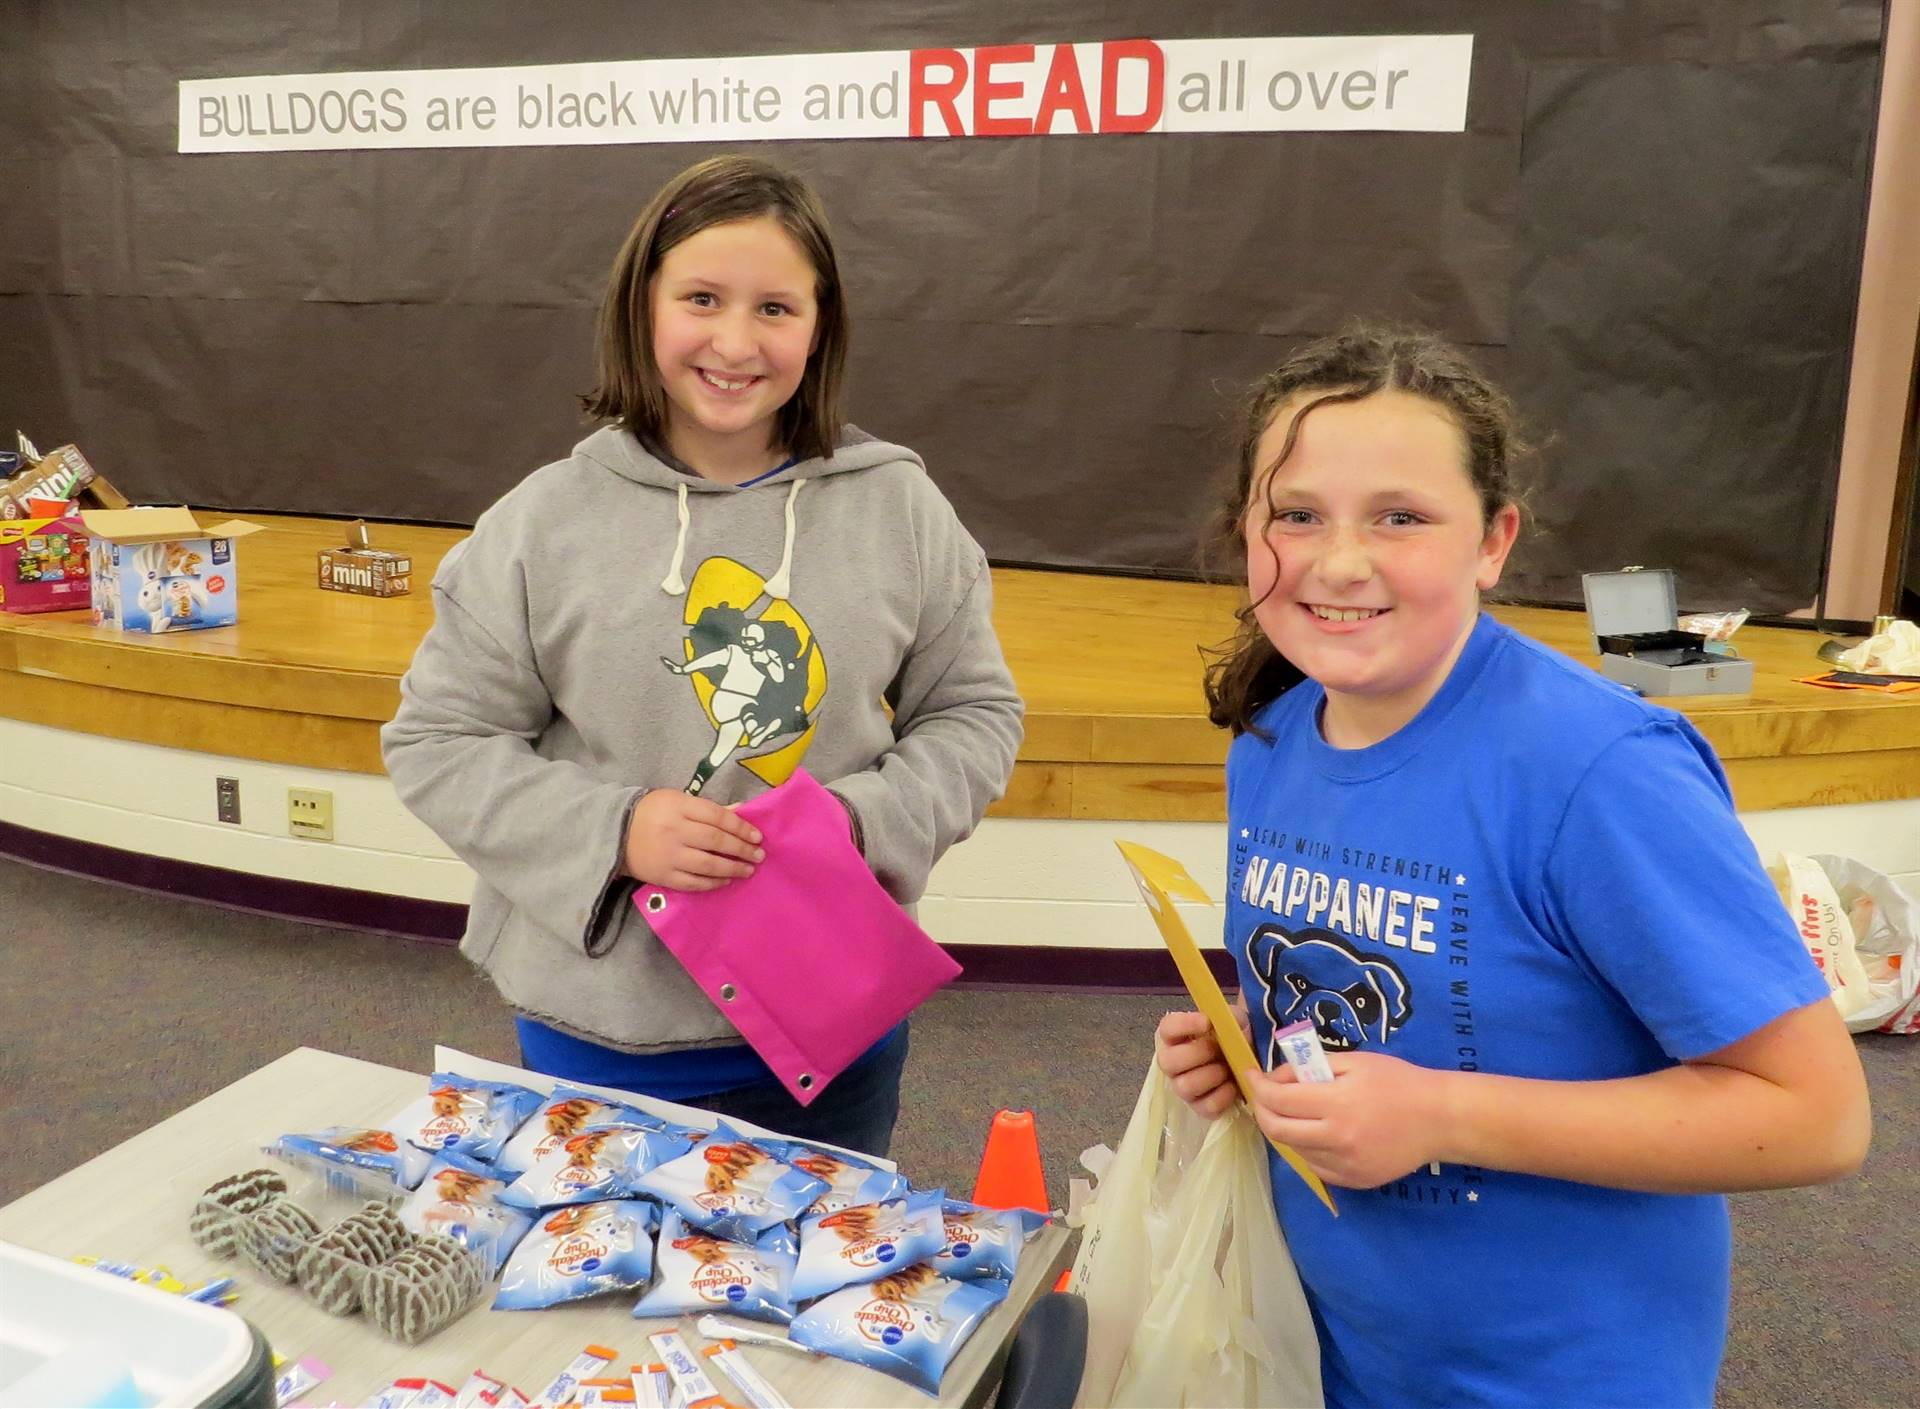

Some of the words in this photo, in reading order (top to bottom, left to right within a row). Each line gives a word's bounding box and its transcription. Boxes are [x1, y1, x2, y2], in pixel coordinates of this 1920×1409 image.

[199, 87, 408, 137] BULLDOGS
[426, 95, 497, 131] are
[517, 81, 637, 129] black
[649, 76, 783, 124] white
[802, 70, 900, 121] and
[908, 38, 1166, 138] READ
[1178, 59, 1247, 113] all
[1266, 67, 1410, 111] over
[333, 564, 372, 588] mini
[1253, 826, 1287, 849] LEAD
[1295, 837, 1331, 861] WITH
[1342, 847, 1451, 885] STRENGTH
[1241, 855, 1441, 954] NAPPANEE
[1449, 892, 1470, 967] LEAVE
[1450, 980, 1474, 1037] WITH
[548, 1245, 608, 1267] Chocolate
[564, 1241, 589, 1254] Chip
[689, 1275, 752, 1289] Chocolate
[705, 1268, 733, 1277] Chip
[854, 1312, 916, 1331] Chocolate
[874, 1304, 901, 1317] Chip
